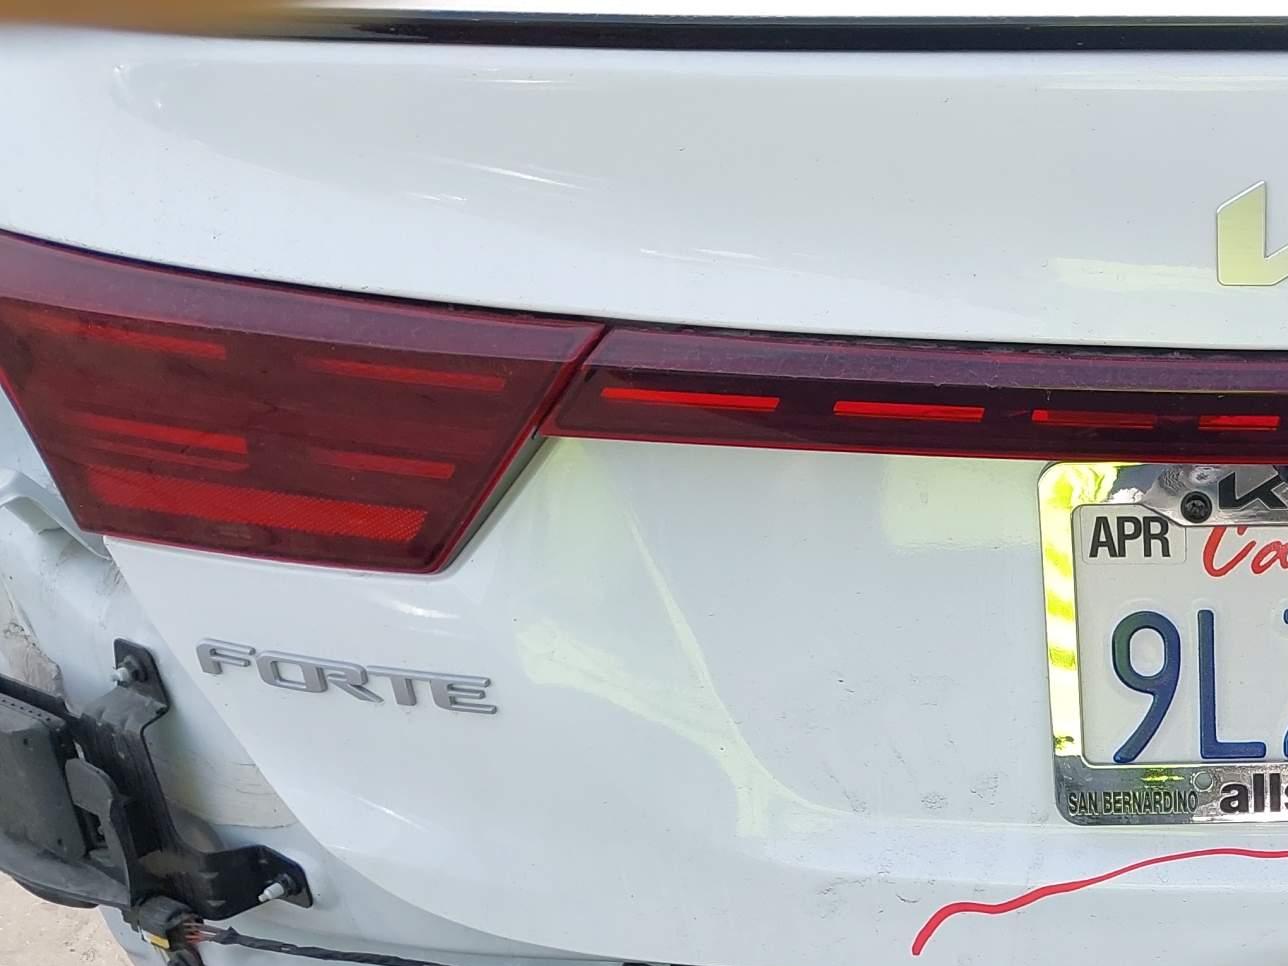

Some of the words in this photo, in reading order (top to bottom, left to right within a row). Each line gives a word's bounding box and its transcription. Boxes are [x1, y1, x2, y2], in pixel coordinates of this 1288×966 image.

[1089, 516, 1171, 558] APR
[196, 638, 498, 715] FORTE
[1068, 791, 1099, 816] SAN
[1103, 790, 1198, 815] BERNARDINO
